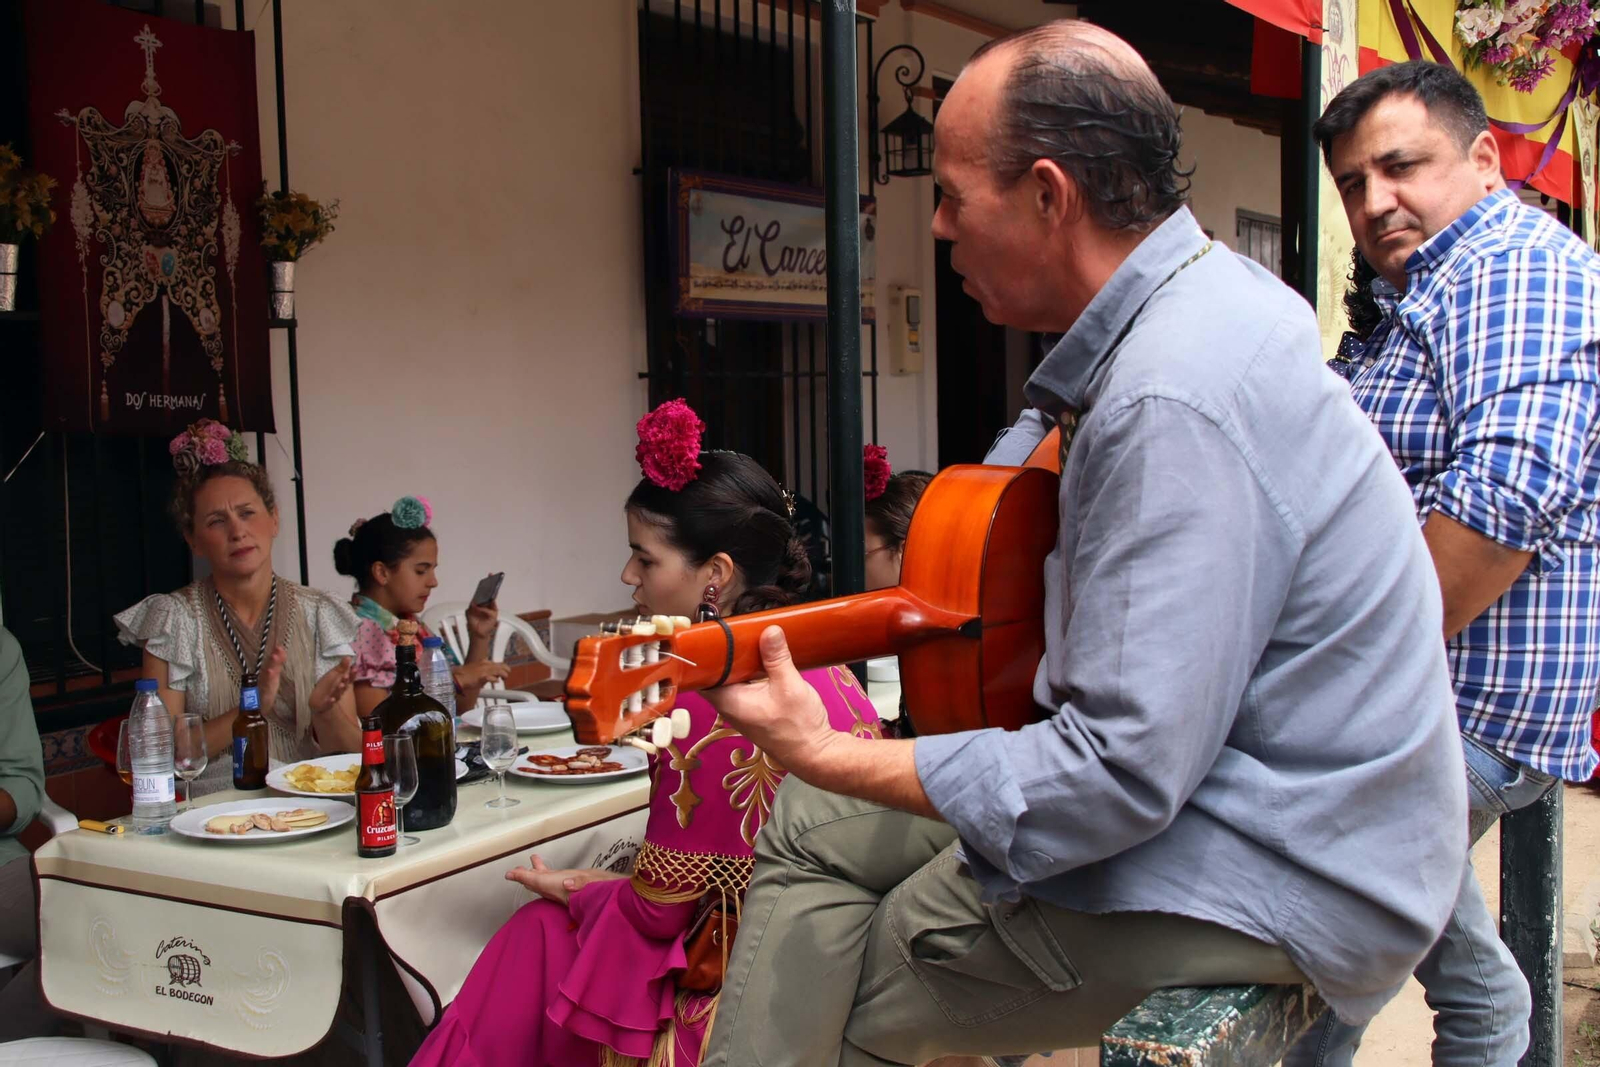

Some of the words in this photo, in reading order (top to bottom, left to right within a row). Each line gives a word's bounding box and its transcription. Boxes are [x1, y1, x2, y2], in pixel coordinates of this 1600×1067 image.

[720, 215, 751, 273] El
[754, 219, 827, 276] Cance
[125, 391, 147, 410] DOS
[149, 392, 207, 410] HERMANAS
[366, 740, 384, 748] PILSE
[366, 824, 396, 834] Cruzcam
[155, 936, 212, 967] Catering
[155, 985, 167, 996] EL
[169, 988, 214, 1006] BODEGON
